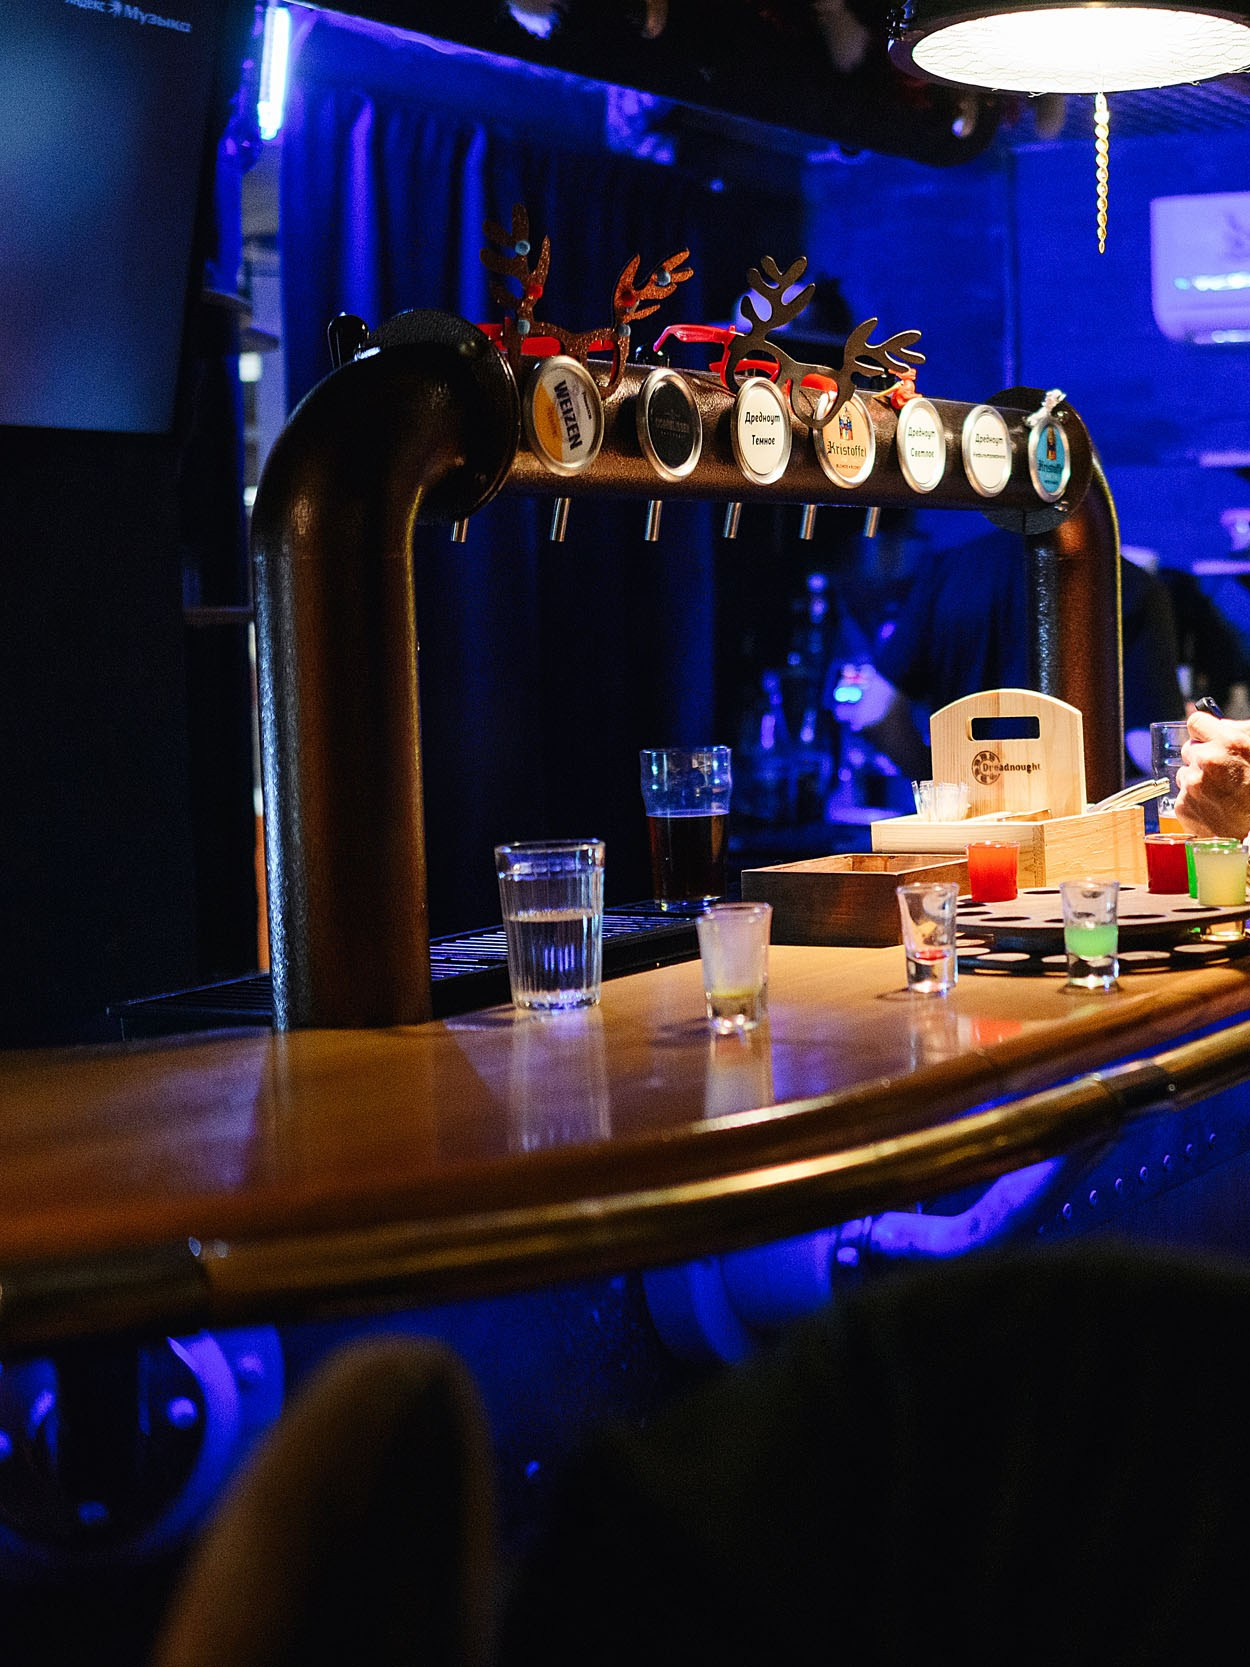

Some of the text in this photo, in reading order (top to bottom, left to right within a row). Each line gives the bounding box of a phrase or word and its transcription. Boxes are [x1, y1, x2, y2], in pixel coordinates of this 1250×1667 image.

[123, 4, 192, 33] Музыка
[553, 379, 583, 451] WEIZEN
[745, 411, 780, 425] Дредноут
[751, 435, 776, 446] Темное
[982, 763, 1041, 774] Dreadnought
